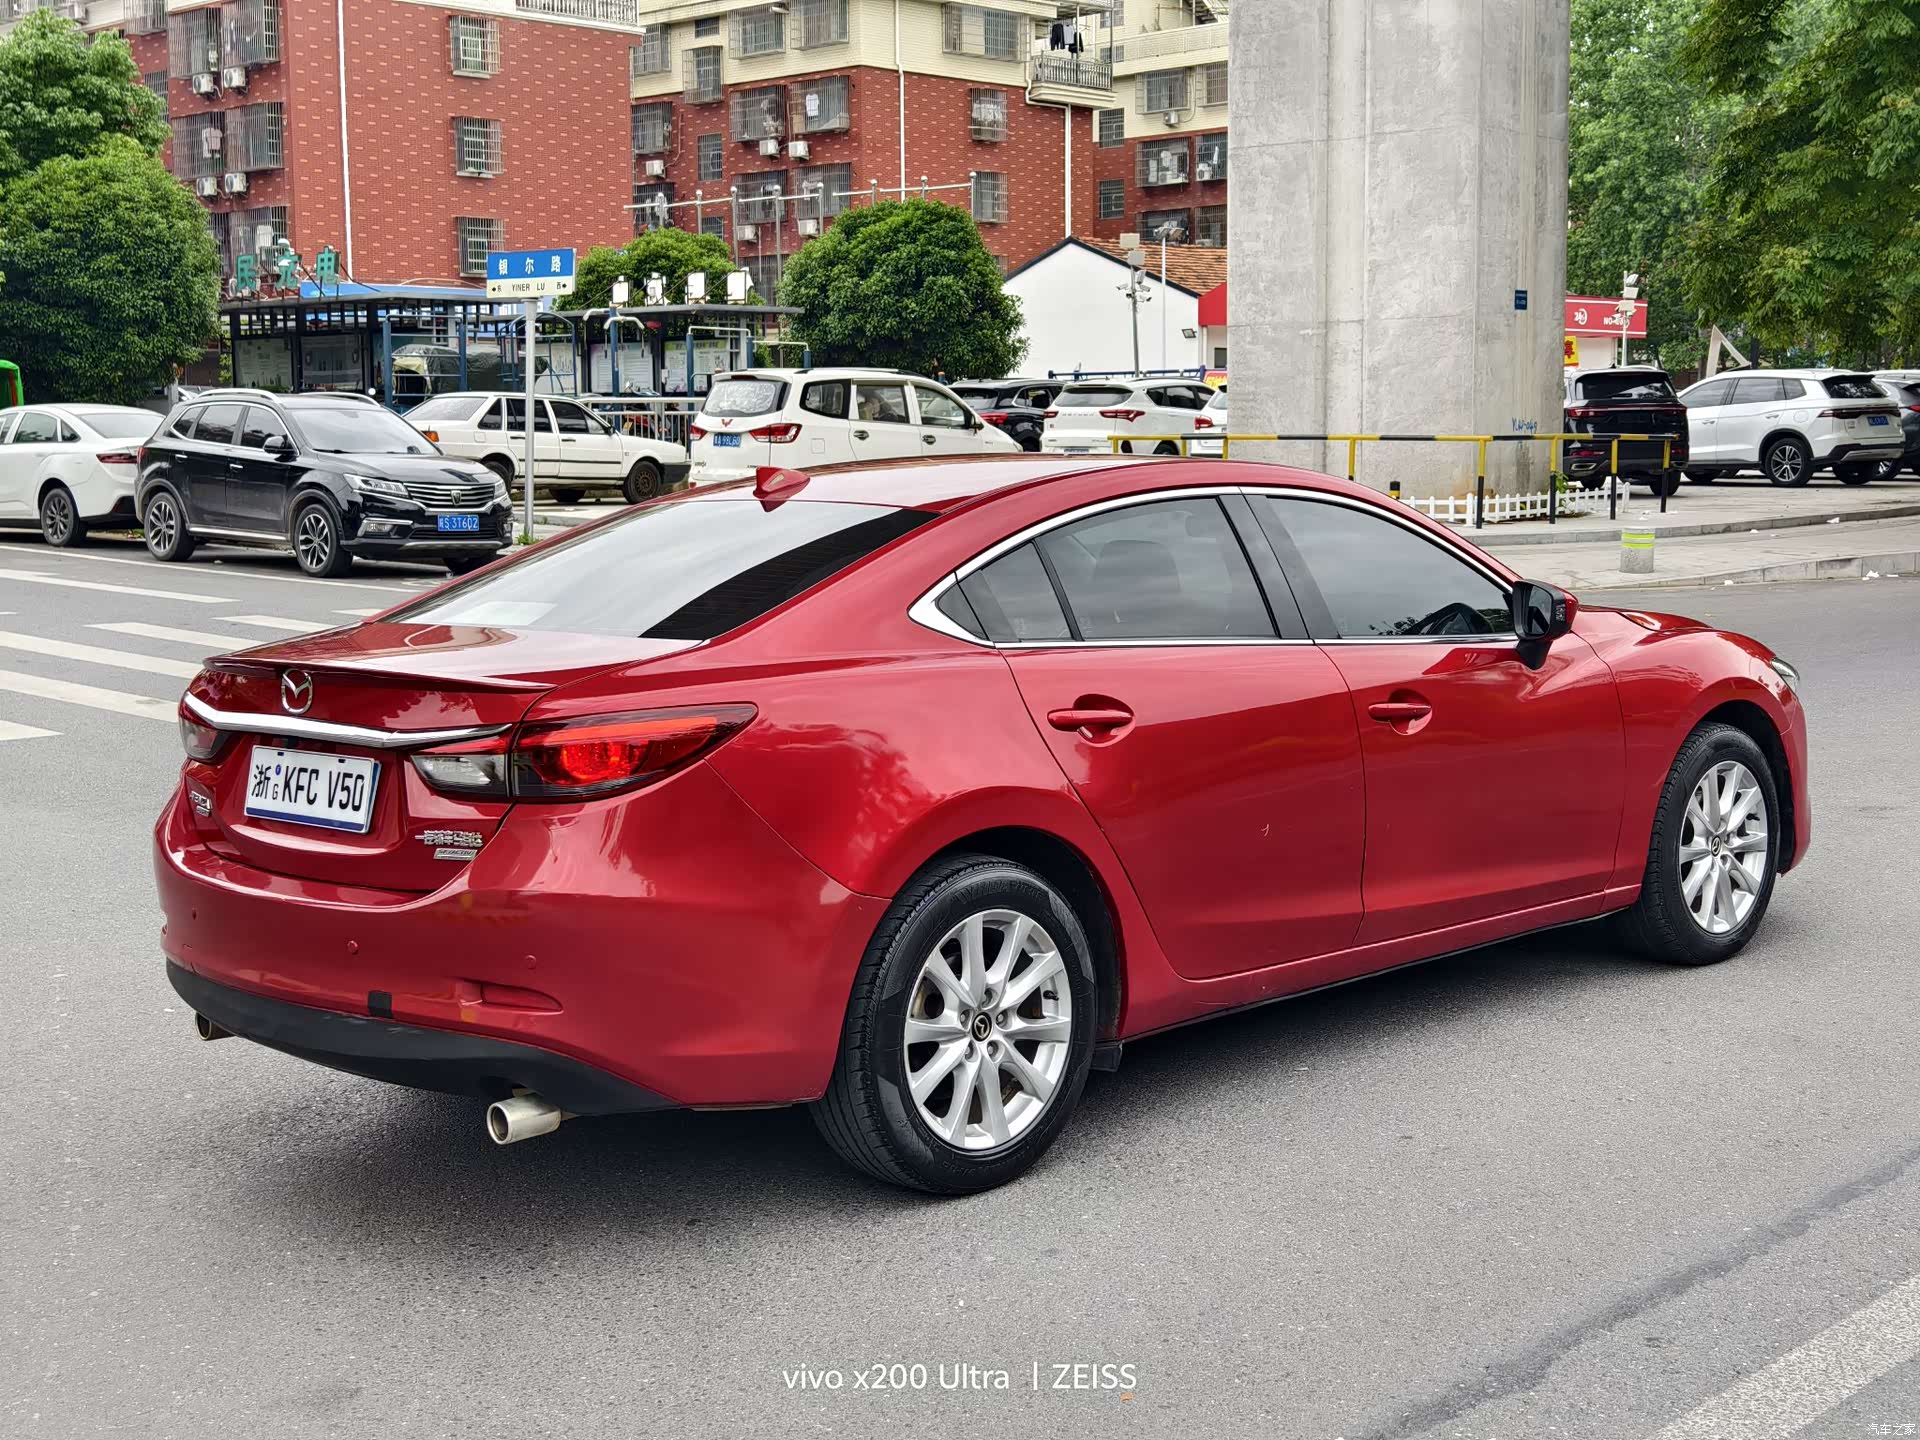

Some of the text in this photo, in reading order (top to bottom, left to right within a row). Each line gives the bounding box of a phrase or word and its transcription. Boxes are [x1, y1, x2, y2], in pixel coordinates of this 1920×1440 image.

[512, 283, 530, 292] YINER
[537, 282, 545, 291] LU
[282, 765, 320, 806] KFC
[328, 770, 365, 812] V50
